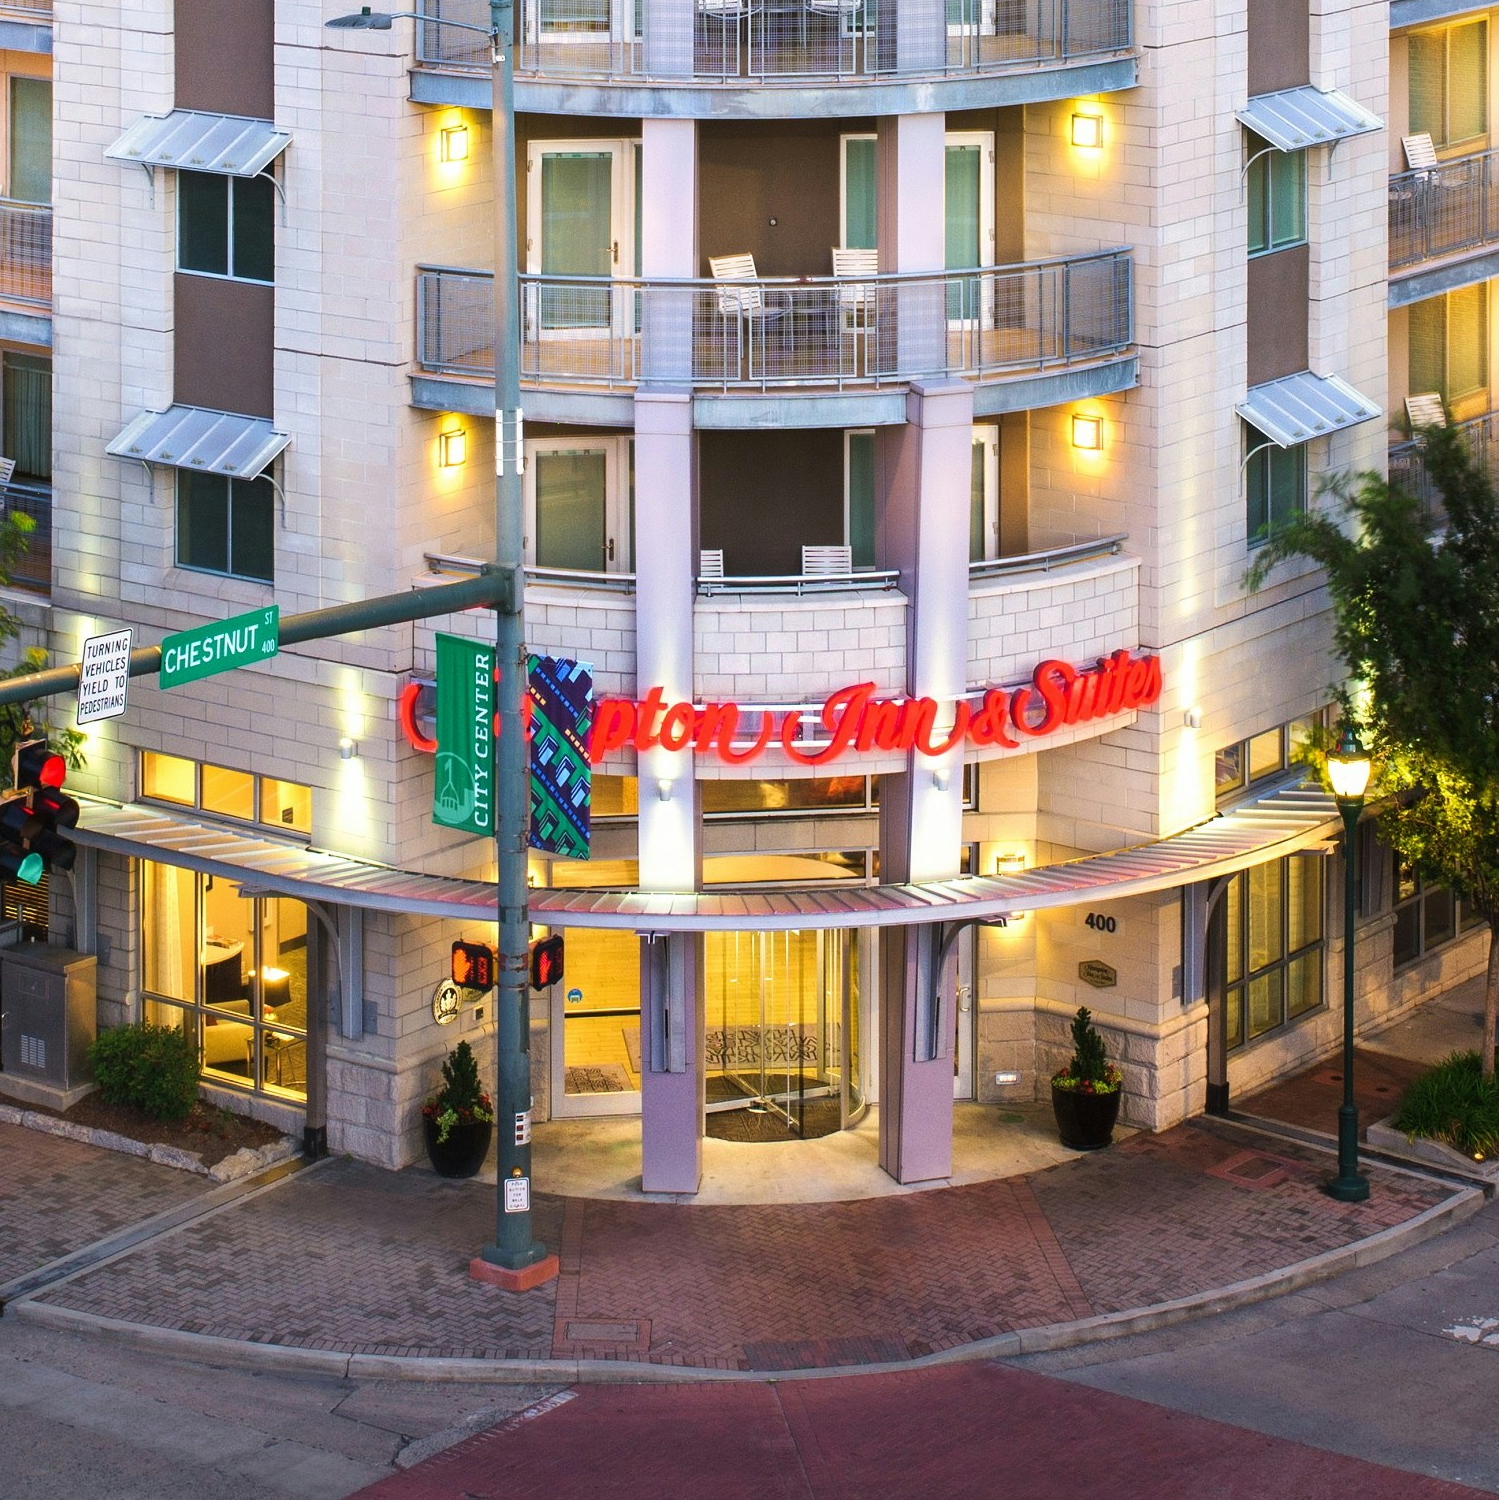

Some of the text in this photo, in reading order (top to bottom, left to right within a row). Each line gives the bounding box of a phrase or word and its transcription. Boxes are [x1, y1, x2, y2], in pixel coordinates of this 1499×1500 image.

[264, 611, 274, 626] ST
[87, 637, 128, 658] TURNING
[165, 624, 259, 674] CHESTNUT
[261, 638, 275, 654] 400
[85, 656, 126, 678] VEHICLES
[82, 674, 125, 697] YIELD TO
[80, 693, 124, 716] PEDESTRIANS
[781, 681, 968, 765] Inn
[965, 688, 1021, 749] &
[1009, 648, 1164, 737] Suites
[474, 654, 490, 827] CITY CENTER
[1085, 912, 1116, 933] 400
